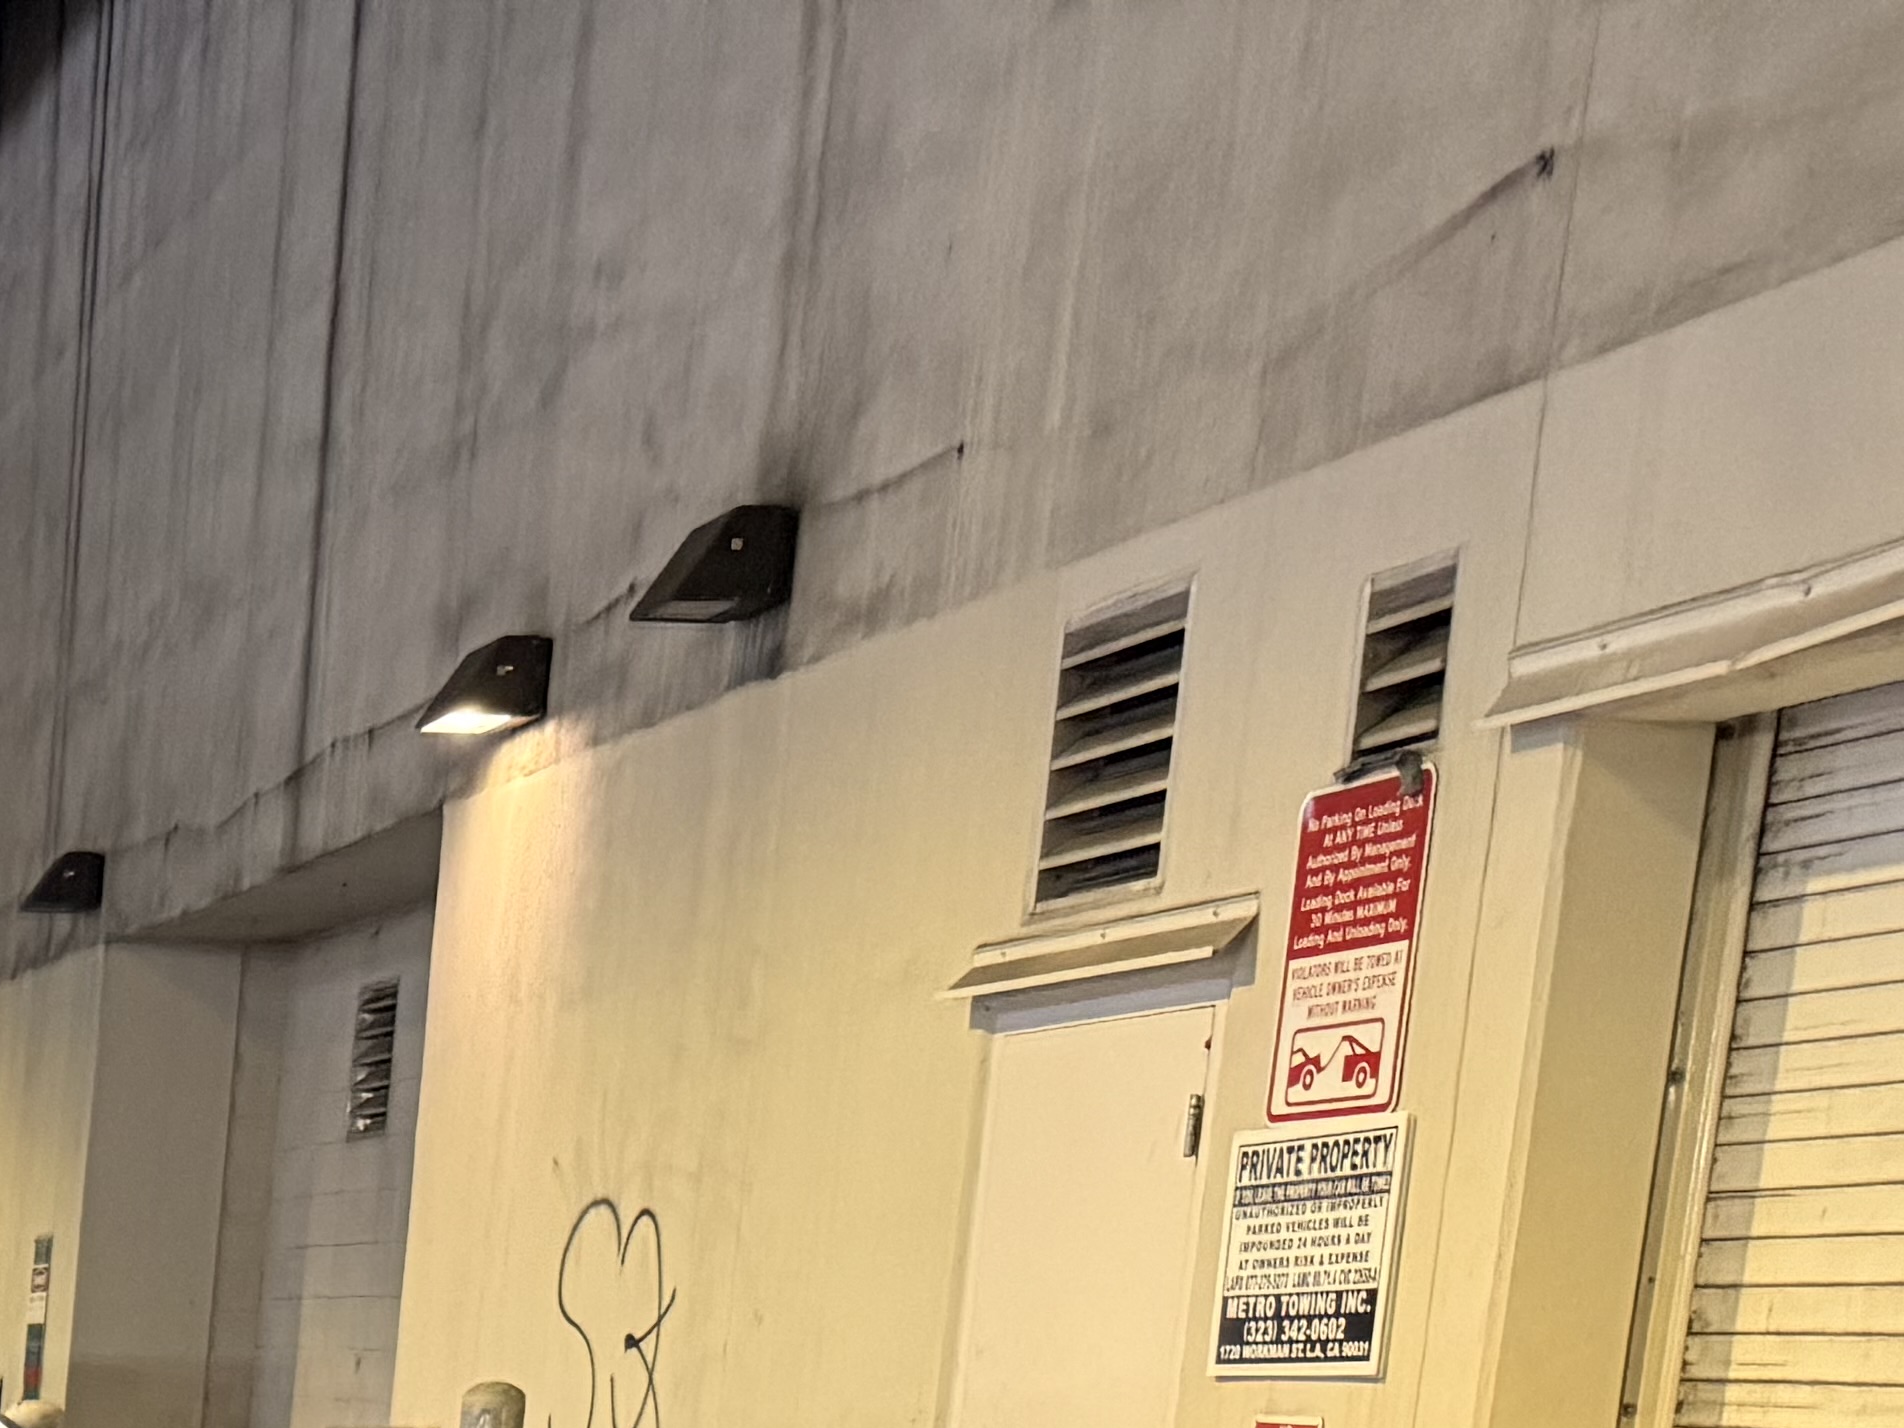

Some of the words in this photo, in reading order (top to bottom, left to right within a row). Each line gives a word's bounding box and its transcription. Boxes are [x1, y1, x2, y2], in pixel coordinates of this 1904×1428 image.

[1321, 812, 1352, 829] Parking
[1355, 807, 1366, 821] On
[1368, 800, 1401, 818] Loading
[1323, 833, 1333, 847] At
[1335, 827, 1354, 844] ANY
[1356, 822, 1375, 840] TIME
[1377, 819, 1403, 835] Unless
[1306, 848, 1349, 869] Authorized
[1351, 845, 1362, 862] By
[1364, 833, 1416, 857] Management
[1305, 872, 1322, 888] And
[1323, 870, 1335, 886] By
[1337, 858, 1389, 884] Appointment
[1300, 894, 1332, 911] Loading
[1334, 889, 1355, 905] Dock
[1357, 881, 1394, 900] Available
[1396, 877, 1411, 892] For
[1324, 910, 1354, 925] Minutes
[1356, 898, 1397, 919] MAXIMUM
[1294, 934, 1325, 950] Loading
[1325, 925, 1343, 943] And
[1345, 922, 1386, 940] Unloading
[1238, 1144, 1305, 1183] PRIVATE
[1308, 1133, 1394, 1175] PROPERTY
[1235, 1202, 1307, 1220] UNAUTHORIZED
[1311, 1200, 1323, 1213] OR
[1246, 1222, 1281, 1235] PARKED
[1286, 1218, 1329, 1232] VEHICLES
[1333, 1216, 1353, 1228] WILL
[1358, 1214, 1369, 1227] BE
[1345, 1233, 1350, 1245] A
[1354, 1232, 1371, 1244] DAY
[1239, 1259, 1249, 1270] AT
[1294, 1255, 1315, 1266] RISK
[1328, 1250, 1369, 1265] EXPENSE
[1226, 1296, 1275, 1318] METRO
[1281, 1292, 1337, 1317] TOWING
[1340, 1290, 1371, 1314] INC.
[1243, 1320, 1278, 1342] (323)
[1281, 1317, 1346, 1341] 342-0602
[1219, 1344, 1240, 1359] 1720
[1242, 1343, 1290, 1358] WORKMAN
[1326, 1342, 1339, 1357] CA
